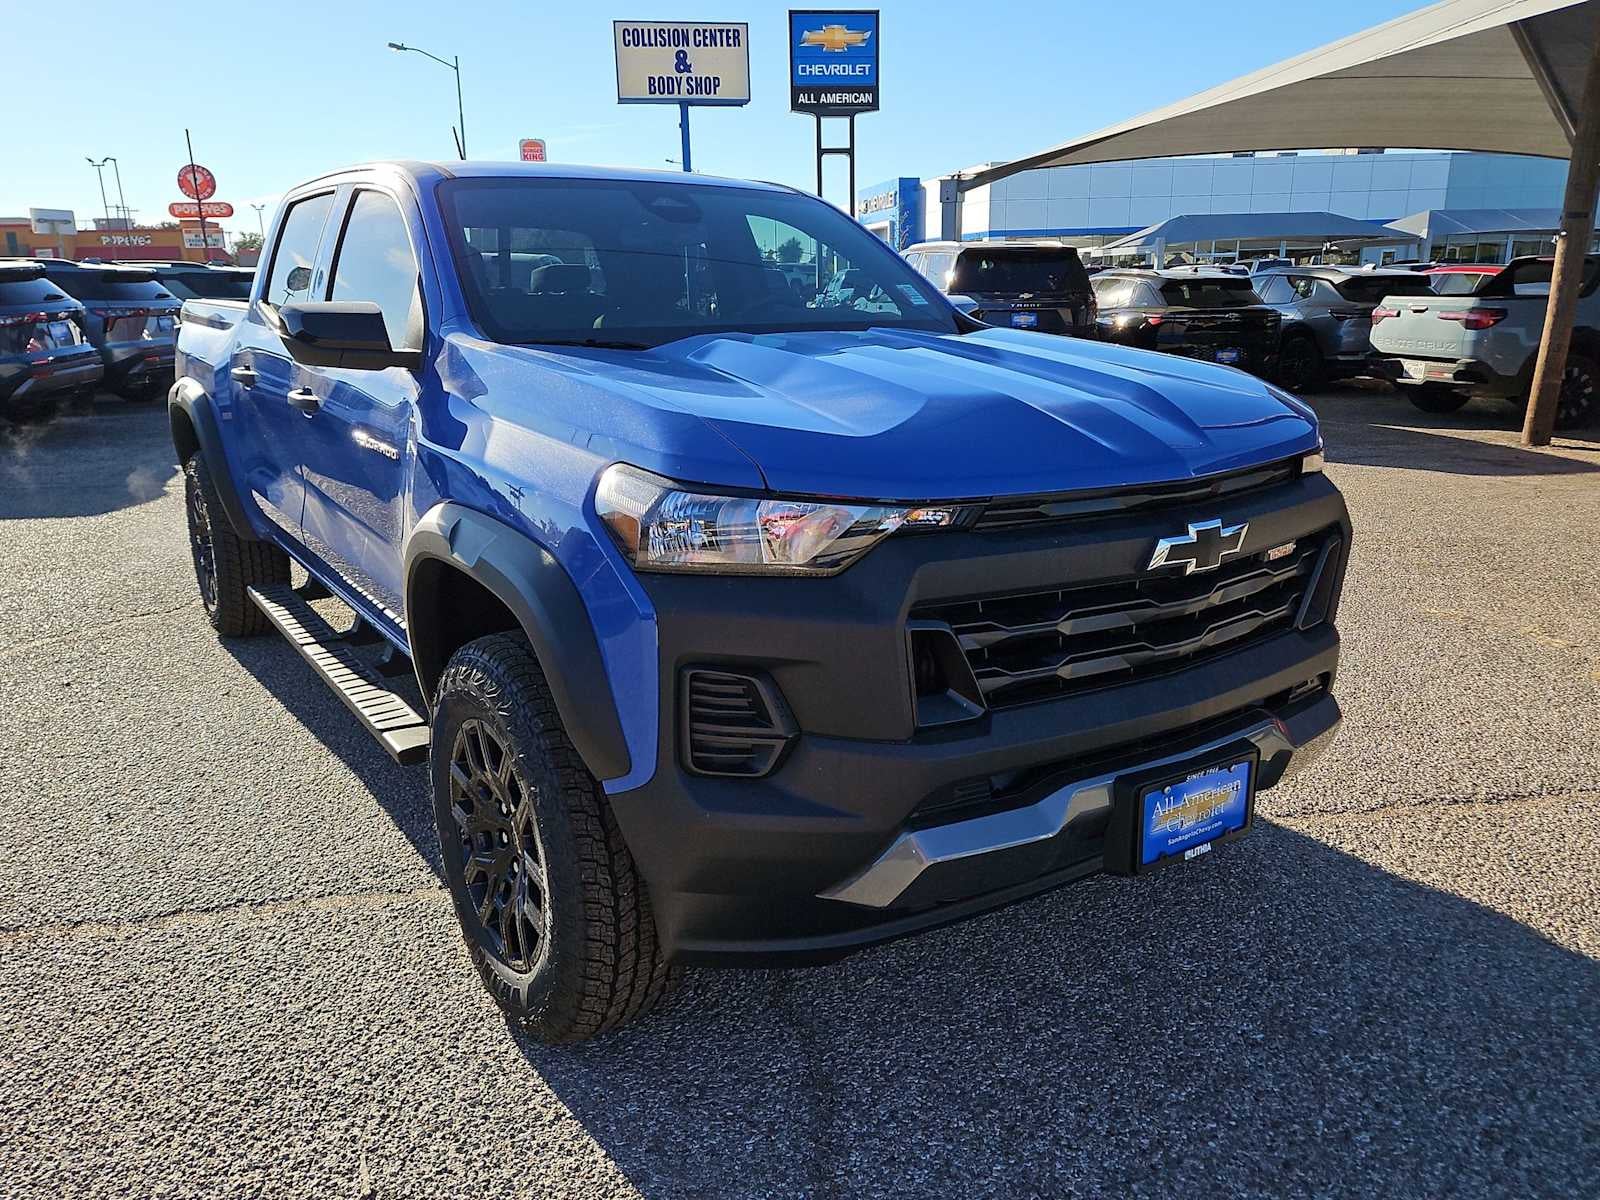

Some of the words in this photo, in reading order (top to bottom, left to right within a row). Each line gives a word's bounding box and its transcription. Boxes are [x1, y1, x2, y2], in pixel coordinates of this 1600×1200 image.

[622, 28, 690, 48] COLLISION
[692, 28, 741, 48] CENTER
[674, 49, 692, 74] &
[798, 64, 871, 76] CHEVROLET
[647, 76, 683, 95] BODY
[686, 76, 720, 96] SHOP
[798, 93, 817, 104] ALL
[820, 93, 873, 104] AMERICAN
[522, 152, 544, 161] KING
[353, 430, 400, 460] ORADO
[1152, 796, 1175, 819] All
[1181, 779, 1241, 808] American
[1166, 801, 1225, 832] Chevrolet
